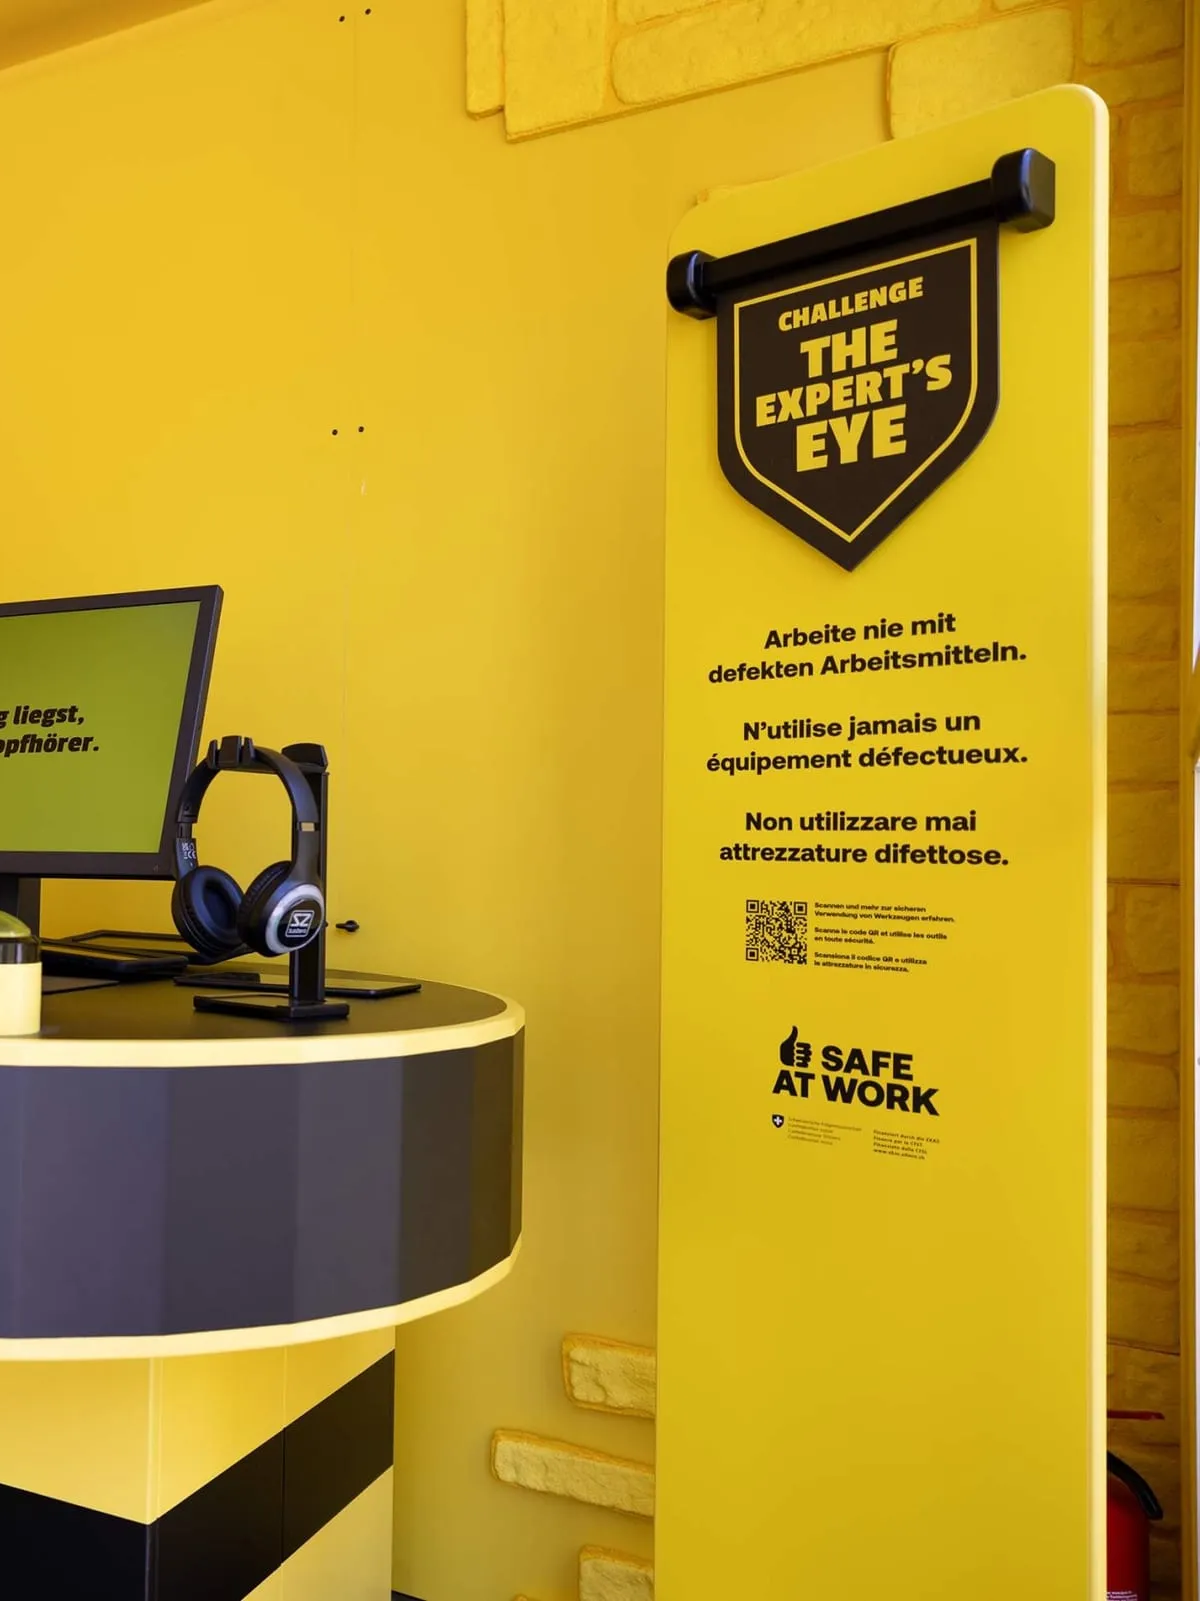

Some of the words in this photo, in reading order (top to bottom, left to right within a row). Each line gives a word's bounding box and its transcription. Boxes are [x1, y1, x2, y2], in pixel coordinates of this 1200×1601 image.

[778, 277, 923, 331] CHALLENGE
[801, 319, 898, 378] THE
[755, 355, 952, 427] EXPERT’S
[796, 404, 907, 472] EYE
[765, 623, 856, 649] Arbeite
[863, 618, 903, 640] nie
[912, 612, 956, 636] mit
[709, 660, 813, 683] defekten
[821, 642, 1027, 675] Arbeitsmitteln.
[13, 705, 84, 727] liegst,
[744, 716, 842, 741] N’utilise
[848, 713, 936, 741] jamais
[945, 712, 980, 730] un
[707, 749, 851, 776] équipement
[859, 747, 1027, 767] défectueux.
[745, 813, 792, 831] Non
[800, 811, 917, 831] utilizzare
[925, 811, 976, 831] mai
[720, 843, 867, 862] attrezzature
[875, 844, 1008, 866] difettose.
[821, 1045, 913, 1081] SAFE
[773, 1070, 815, 1098] AT
[822, 1074, 939, 1116] WORK
